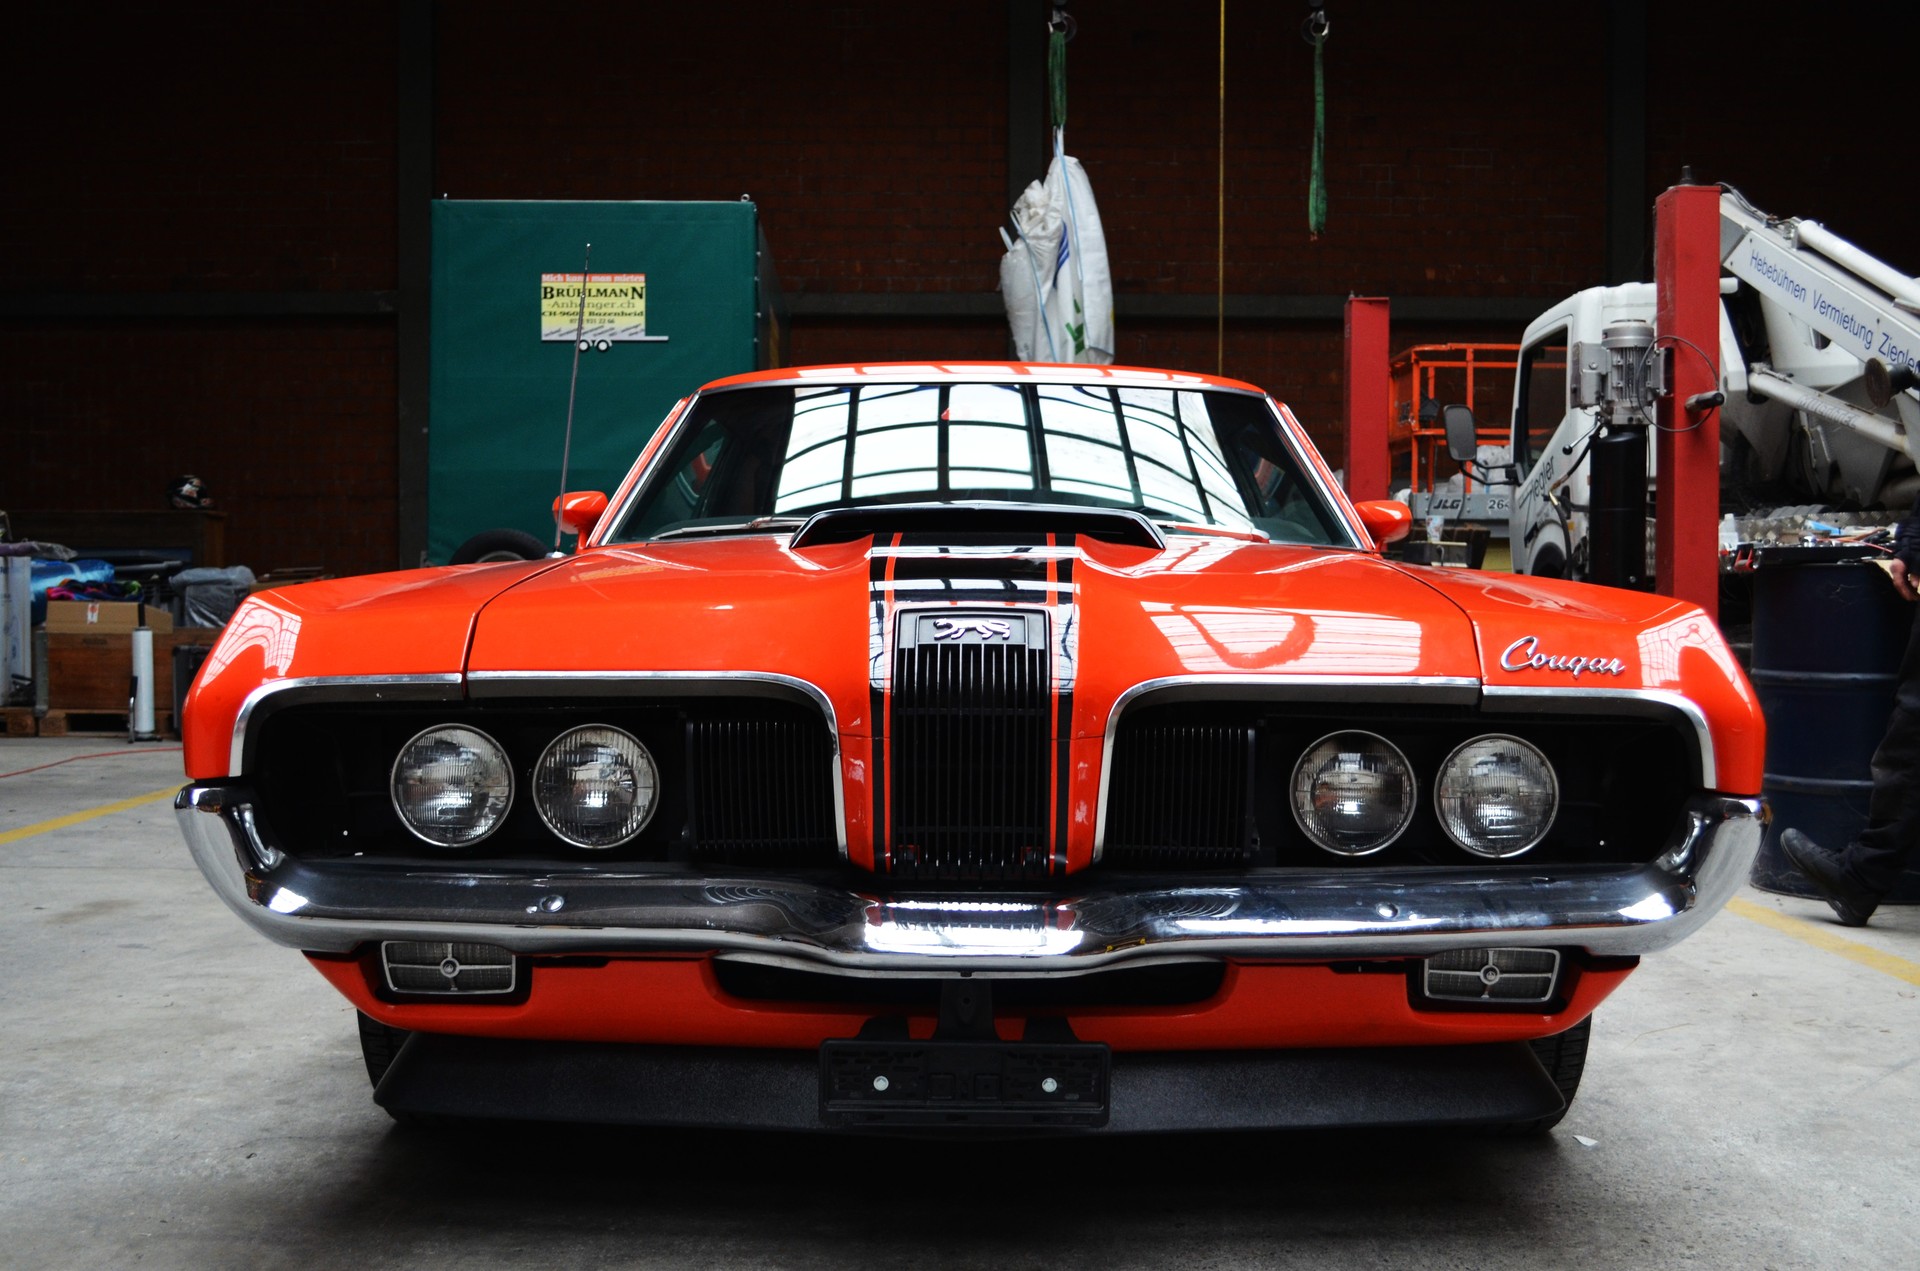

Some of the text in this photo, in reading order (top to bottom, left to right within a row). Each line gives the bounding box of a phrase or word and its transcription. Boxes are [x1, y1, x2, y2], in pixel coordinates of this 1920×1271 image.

[1750, 250, 1807, 303] Hebebühnen
[1813, 289, 1873, 350] Vermietung
[1433, 499, 1462, 510] JLG
[1500, 635, 1626, 680] Cougar
